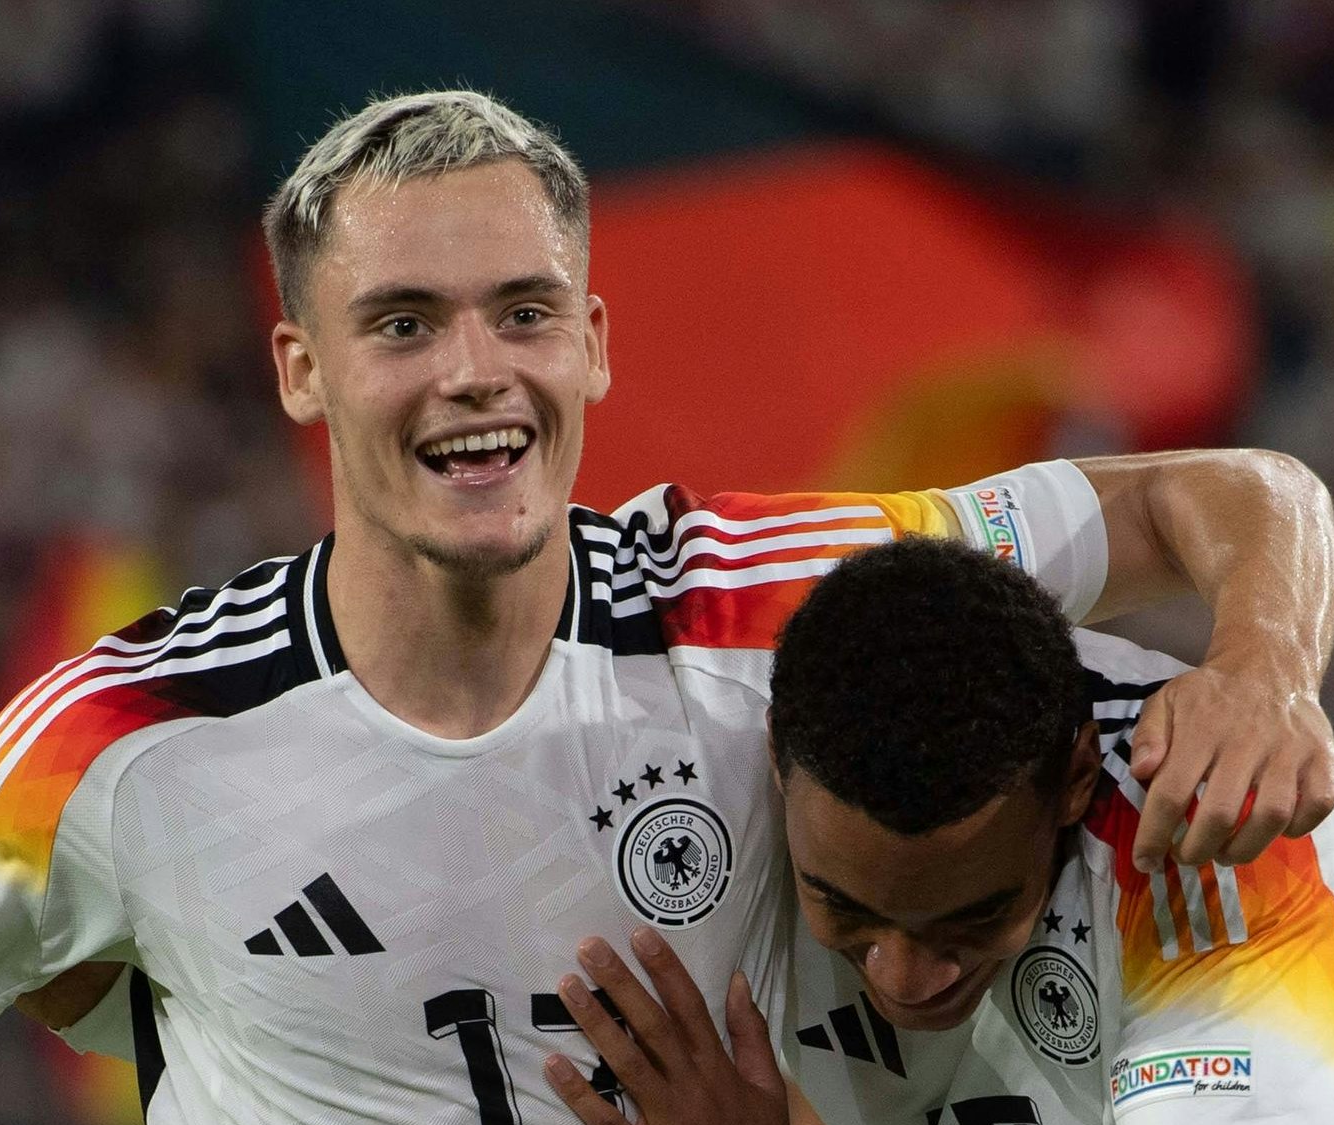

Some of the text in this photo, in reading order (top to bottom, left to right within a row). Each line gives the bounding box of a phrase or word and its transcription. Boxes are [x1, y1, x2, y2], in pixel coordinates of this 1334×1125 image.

[635, 815, 694, 856] DEUTSCHER
[649, 854, 719, 909] FUSSBALL-BUND
[1025, 962, 1075, 987] DEUTSCHER
[1033, 1015, 1095, 1050] FUSSBALL-BUND
[1193, 1080, 1251, 1095] for children
